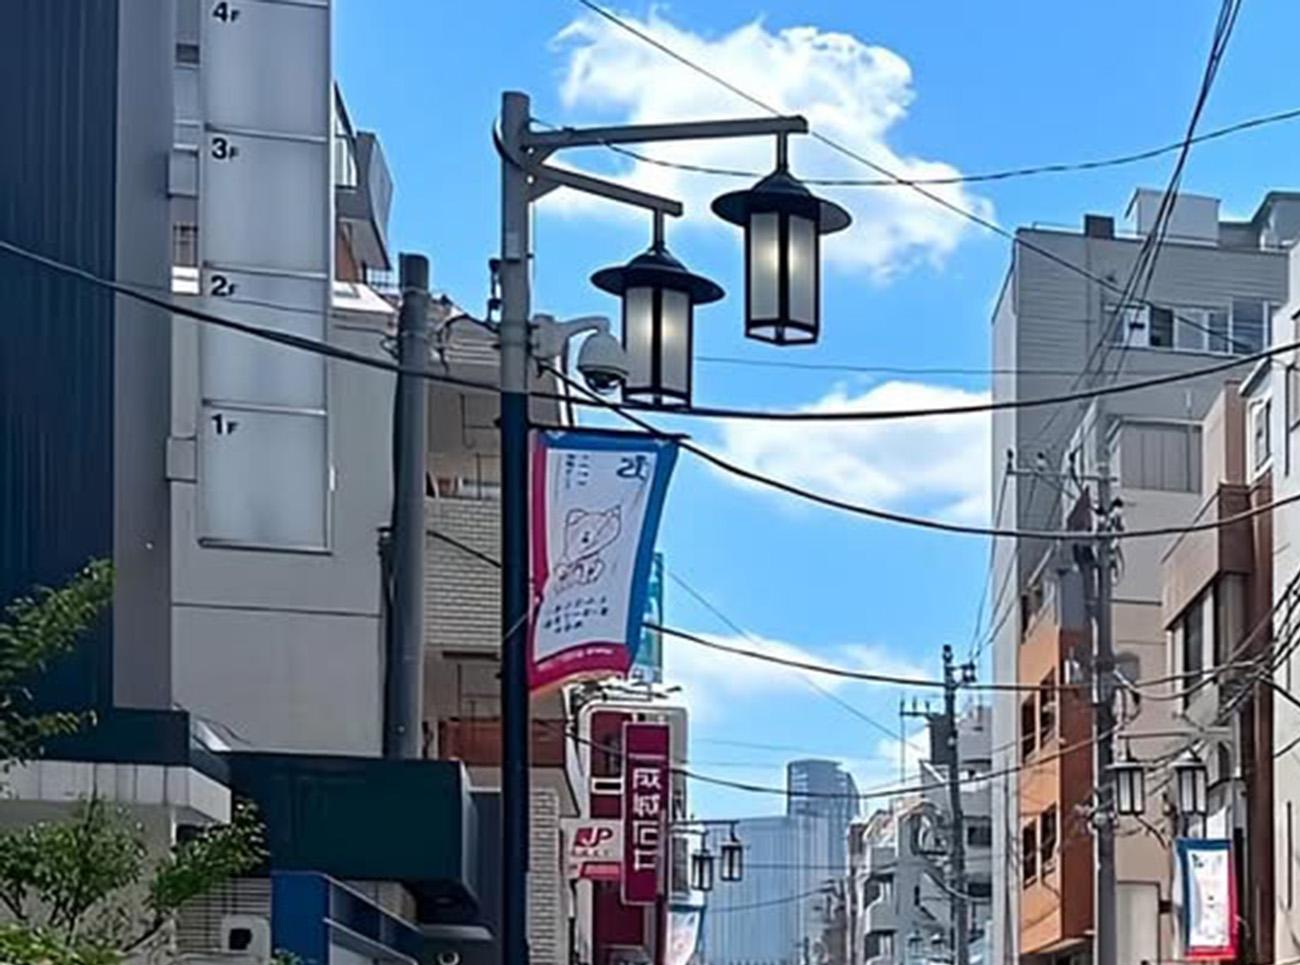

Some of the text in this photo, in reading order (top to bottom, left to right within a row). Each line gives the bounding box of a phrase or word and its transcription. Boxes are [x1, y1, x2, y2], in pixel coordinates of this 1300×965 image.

[212, 1, 240, 22] 4F
[211, 137, 240, 160] 3F
[211, 275, 240, 297] 2F
[211, 413, 239, 435] 1F
